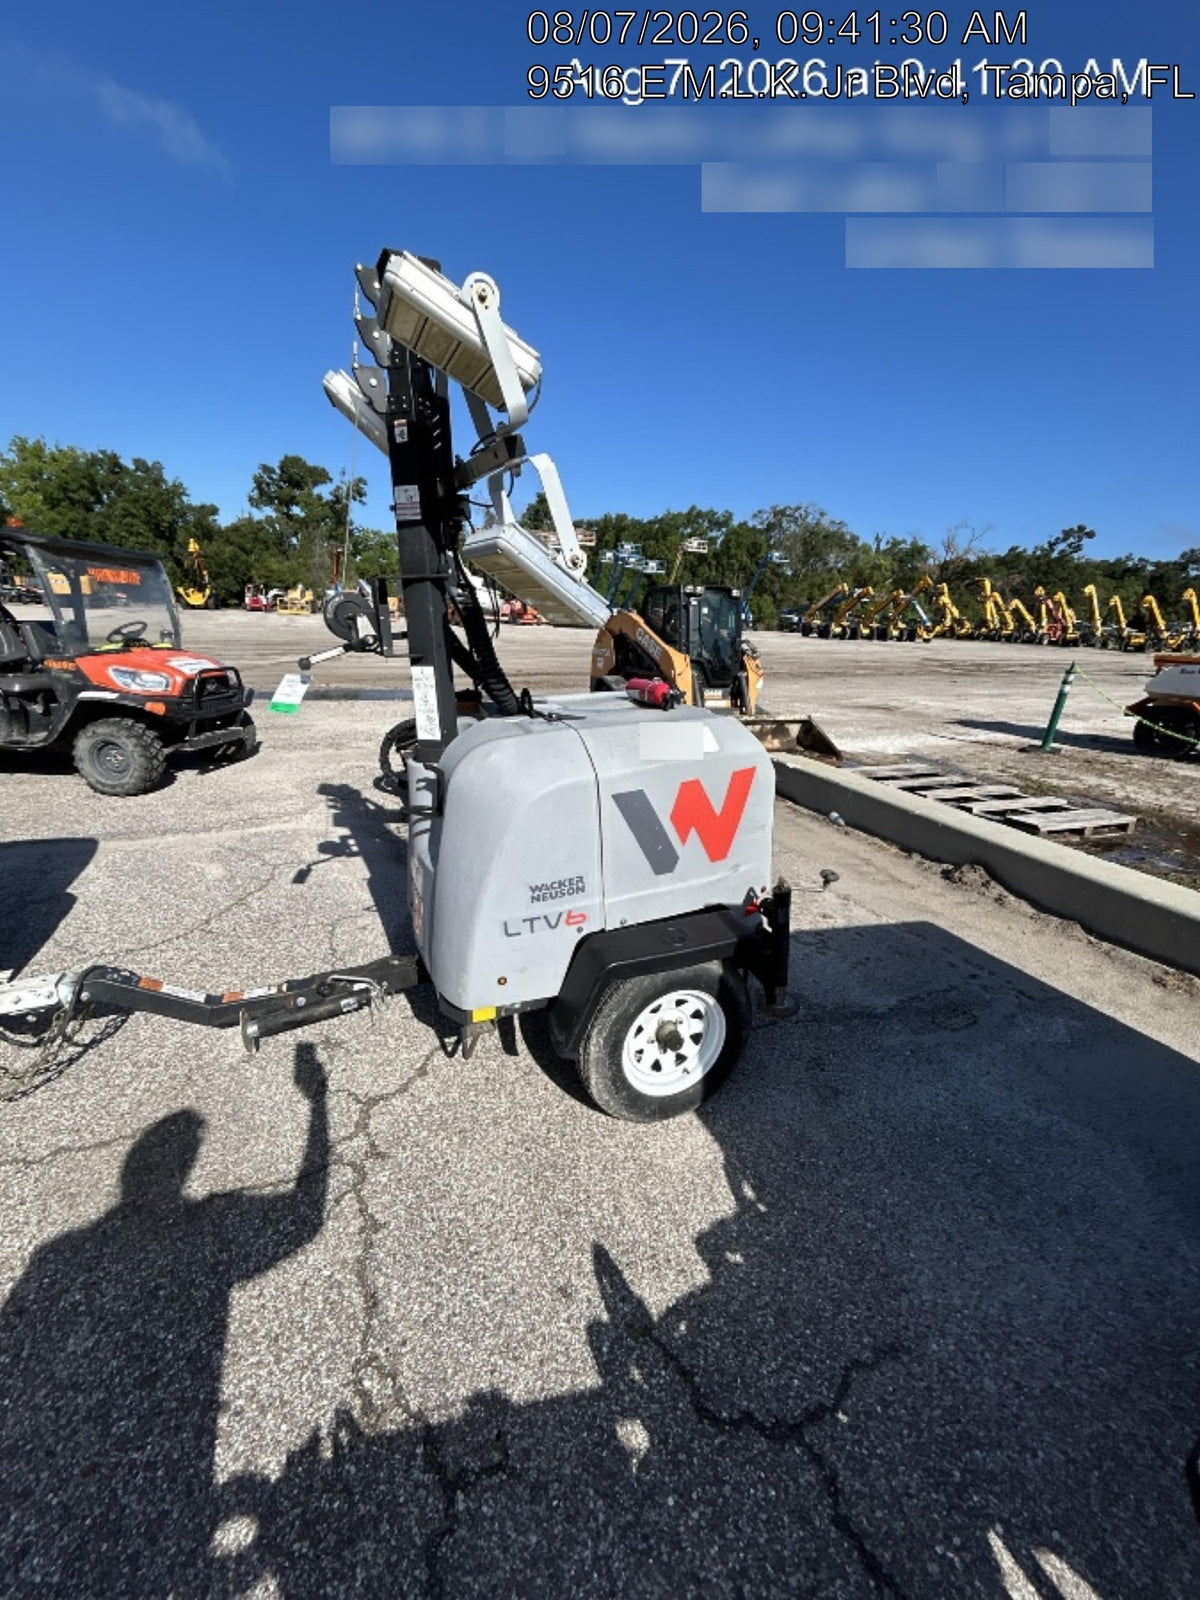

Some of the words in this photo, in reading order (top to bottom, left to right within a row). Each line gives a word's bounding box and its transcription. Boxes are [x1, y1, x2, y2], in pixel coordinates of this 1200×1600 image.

[635, 627, 662, 660] CASE
[529, 876, 584, 895] WACKER
[530, 884, 586, 903] NEUSON
[503, 910, 588, 938] LTV6
